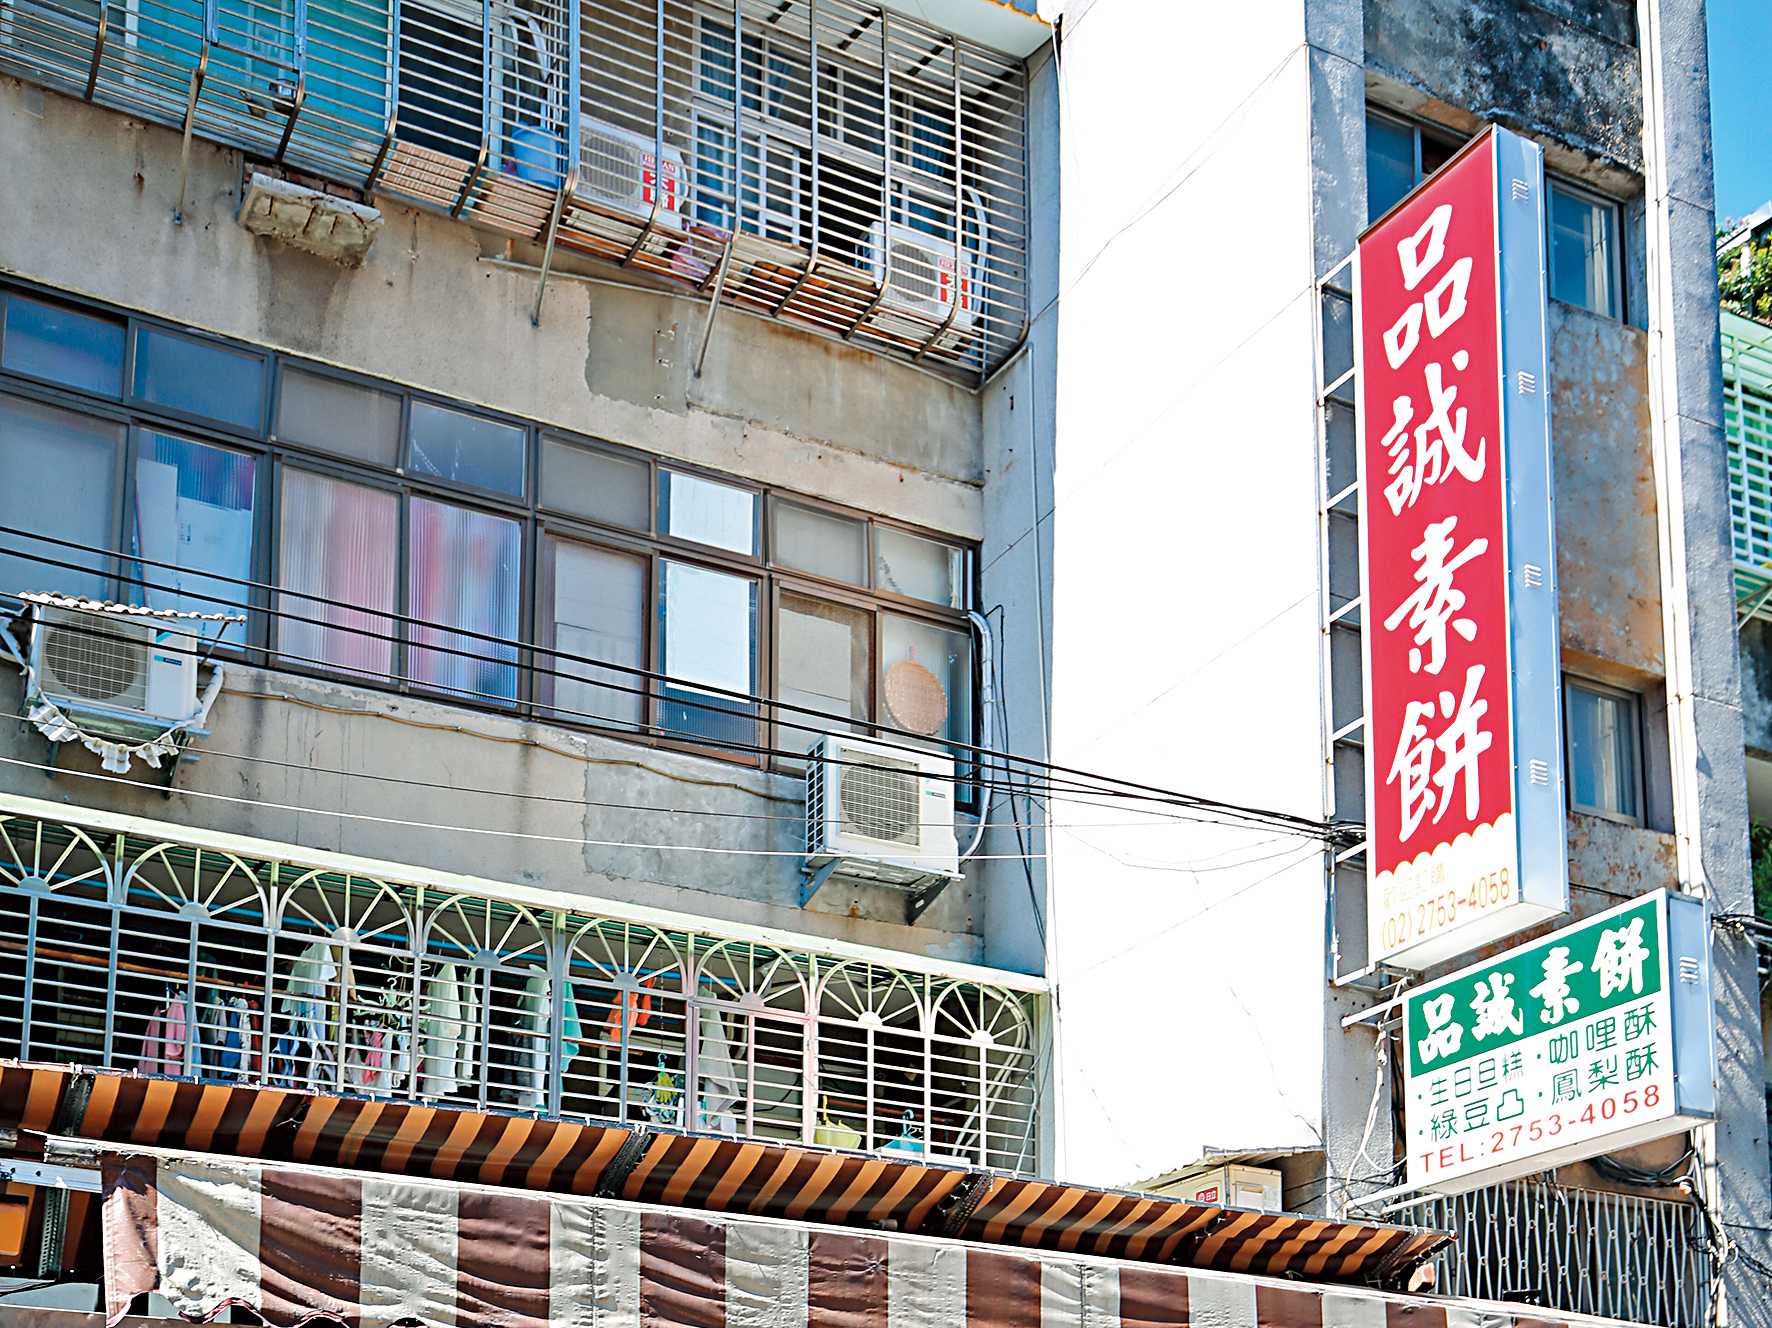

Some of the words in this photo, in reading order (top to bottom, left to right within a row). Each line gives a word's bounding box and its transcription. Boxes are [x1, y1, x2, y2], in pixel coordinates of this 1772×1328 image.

[643, 154, 675, 172] HEAN
[1382, 204, 1493, 845] 品誠素餅
[1417, 917, 1650, 1065] 品誠素餅
